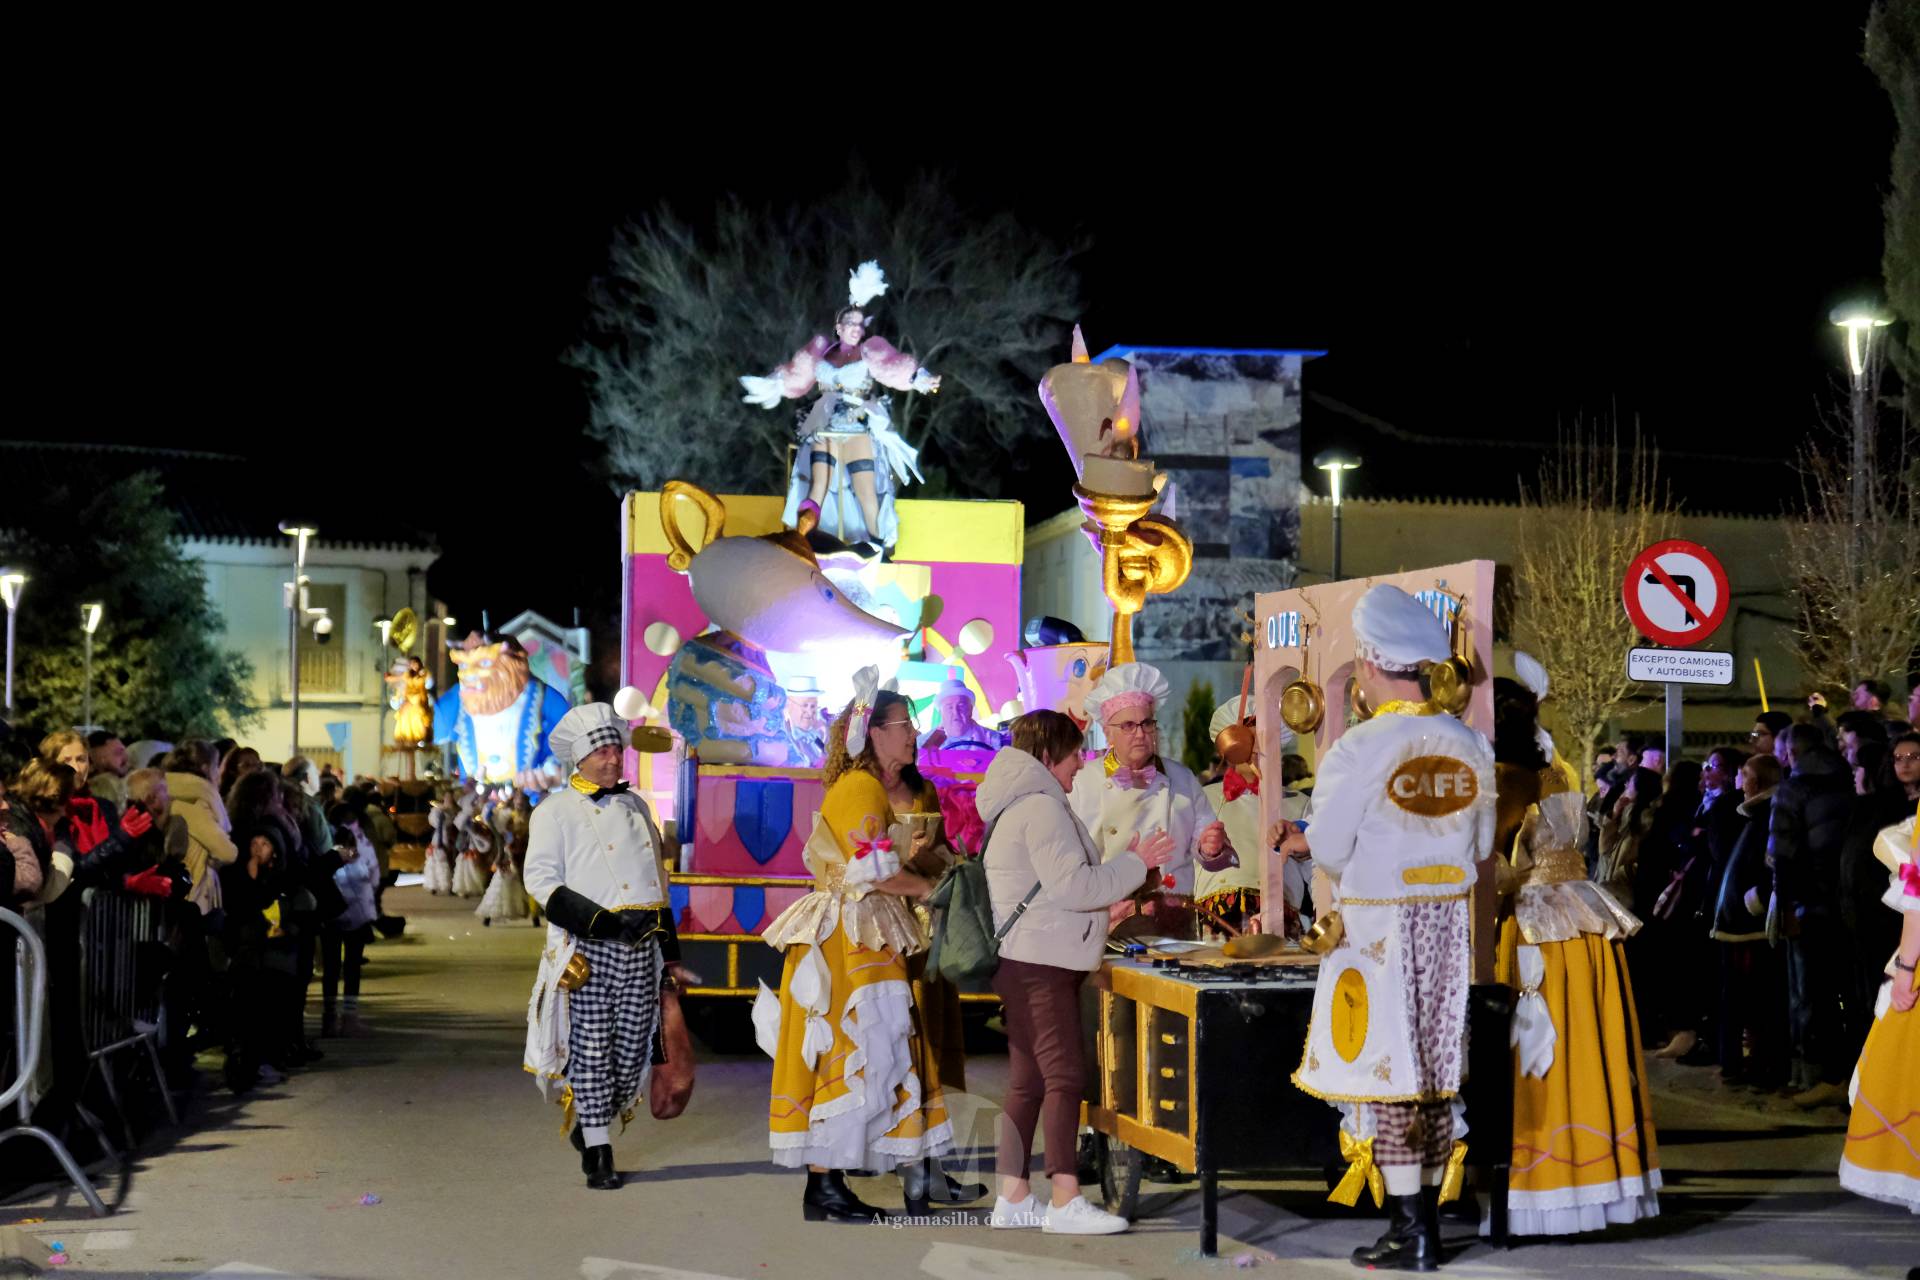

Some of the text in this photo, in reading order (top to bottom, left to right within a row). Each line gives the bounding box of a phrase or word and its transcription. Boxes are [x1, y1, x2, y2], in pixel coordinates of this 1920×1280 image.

[1631, 654, 1731, 667] EXCEPTO CAMIONES
[1647, 667, 1715, 678] Y AUTOBUSES
[1392, 765, 1473, 799] CAFÉ
